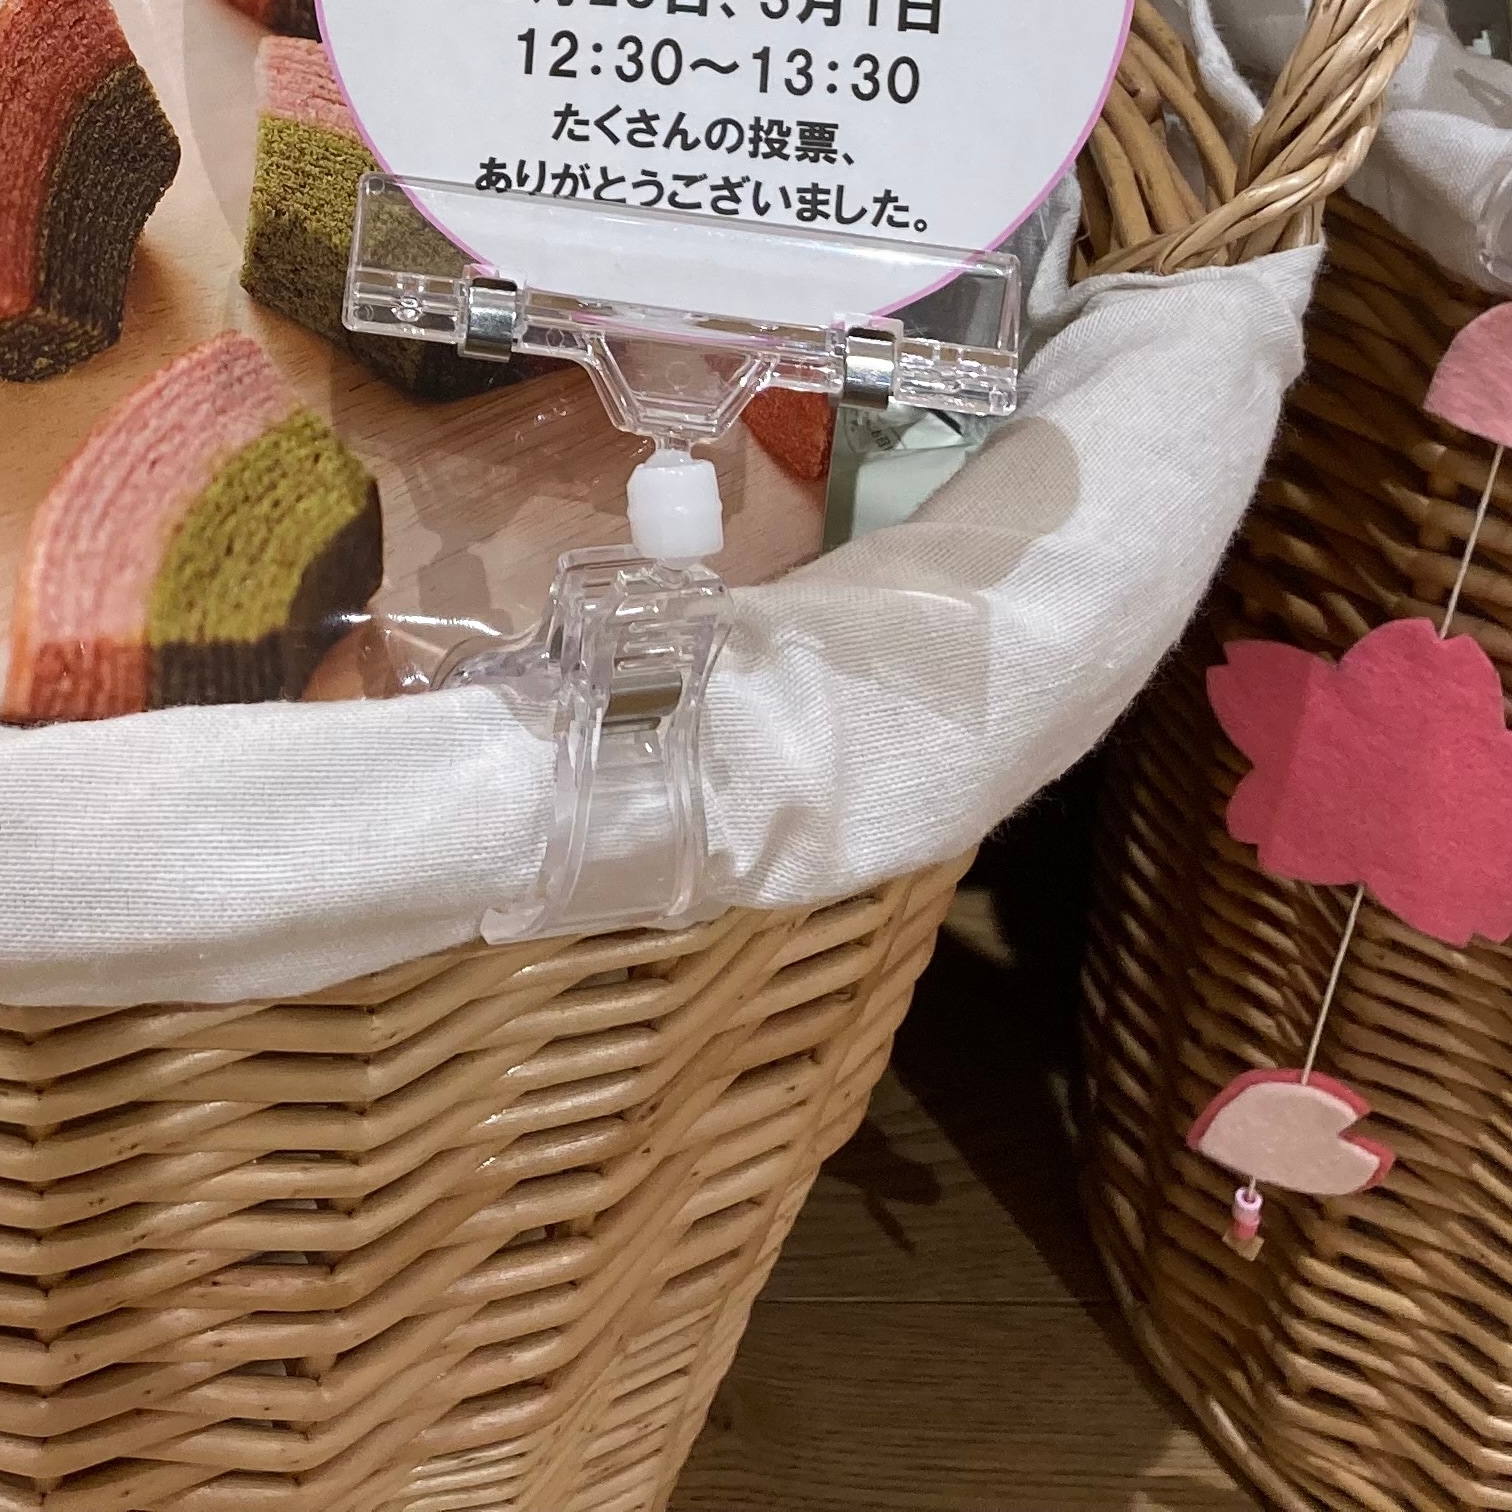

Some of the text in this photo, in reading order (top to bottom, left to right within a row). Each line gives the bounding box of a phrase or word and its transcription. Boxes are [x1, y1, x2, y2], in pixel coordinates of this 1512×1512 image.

[552, 102, 856, 166] たくさんの投票、
[475, 156, 928, 233] ありがとうございました。
